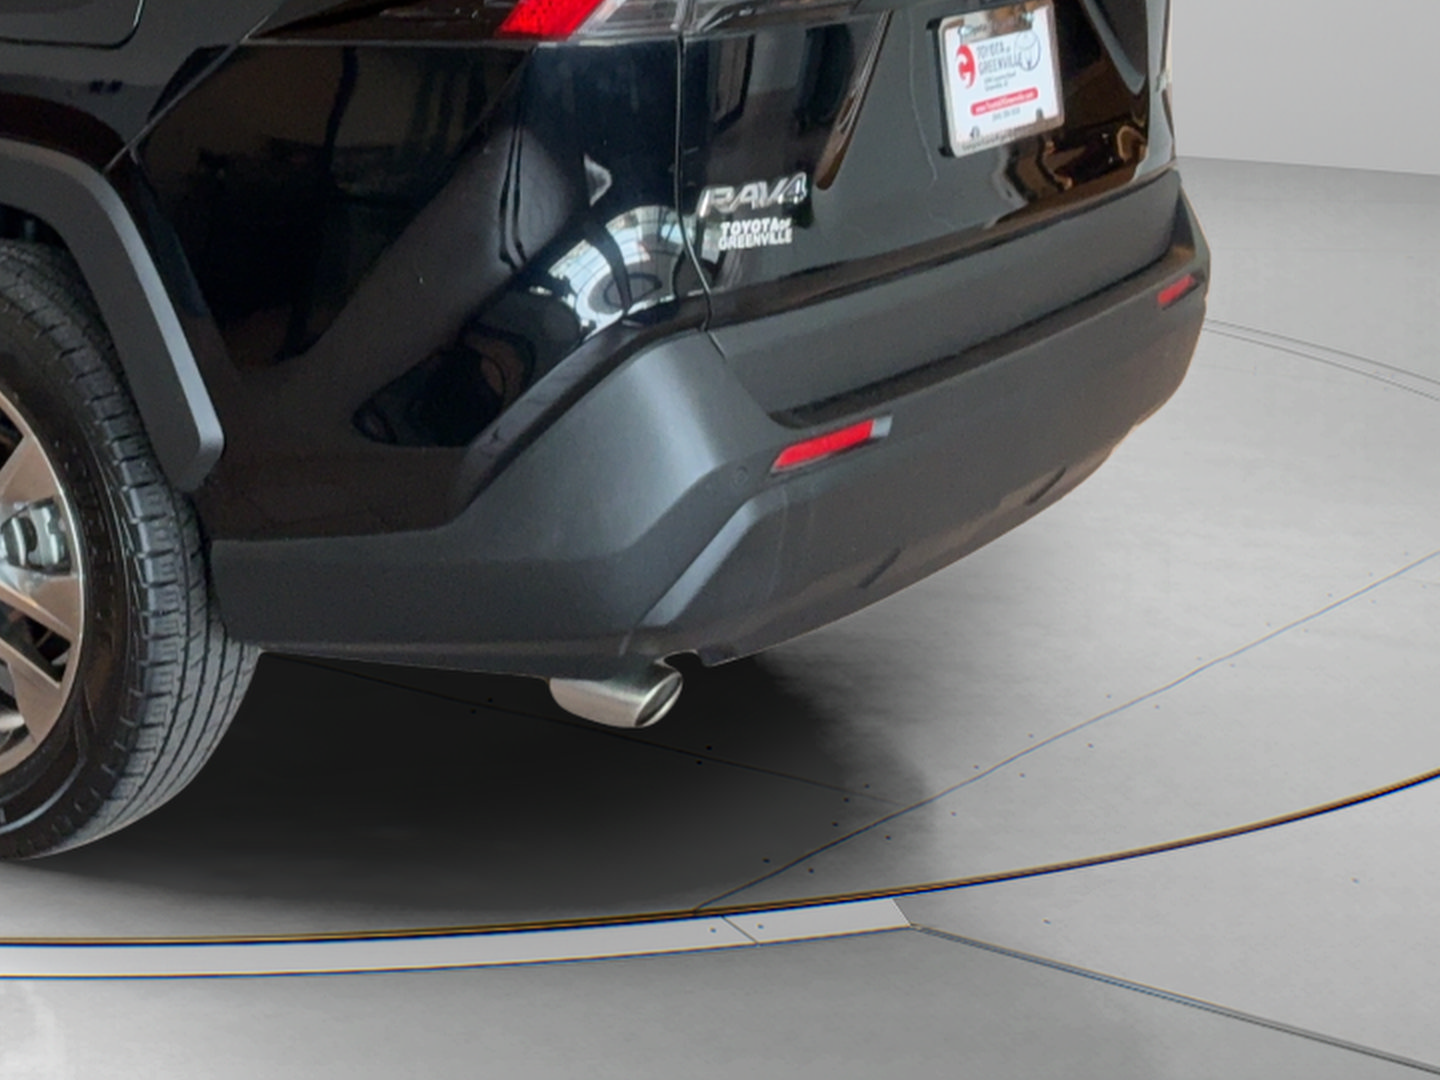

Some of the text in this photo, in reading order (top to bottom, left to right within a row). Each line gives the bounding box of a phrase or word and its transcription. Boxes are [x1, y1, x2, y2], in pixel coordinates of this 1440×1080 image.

[699, 171, 808, 218] RAV4
[718, 227, 793, 251] GREENVILLE
[720, 217, 781, 237] TOYOTA
